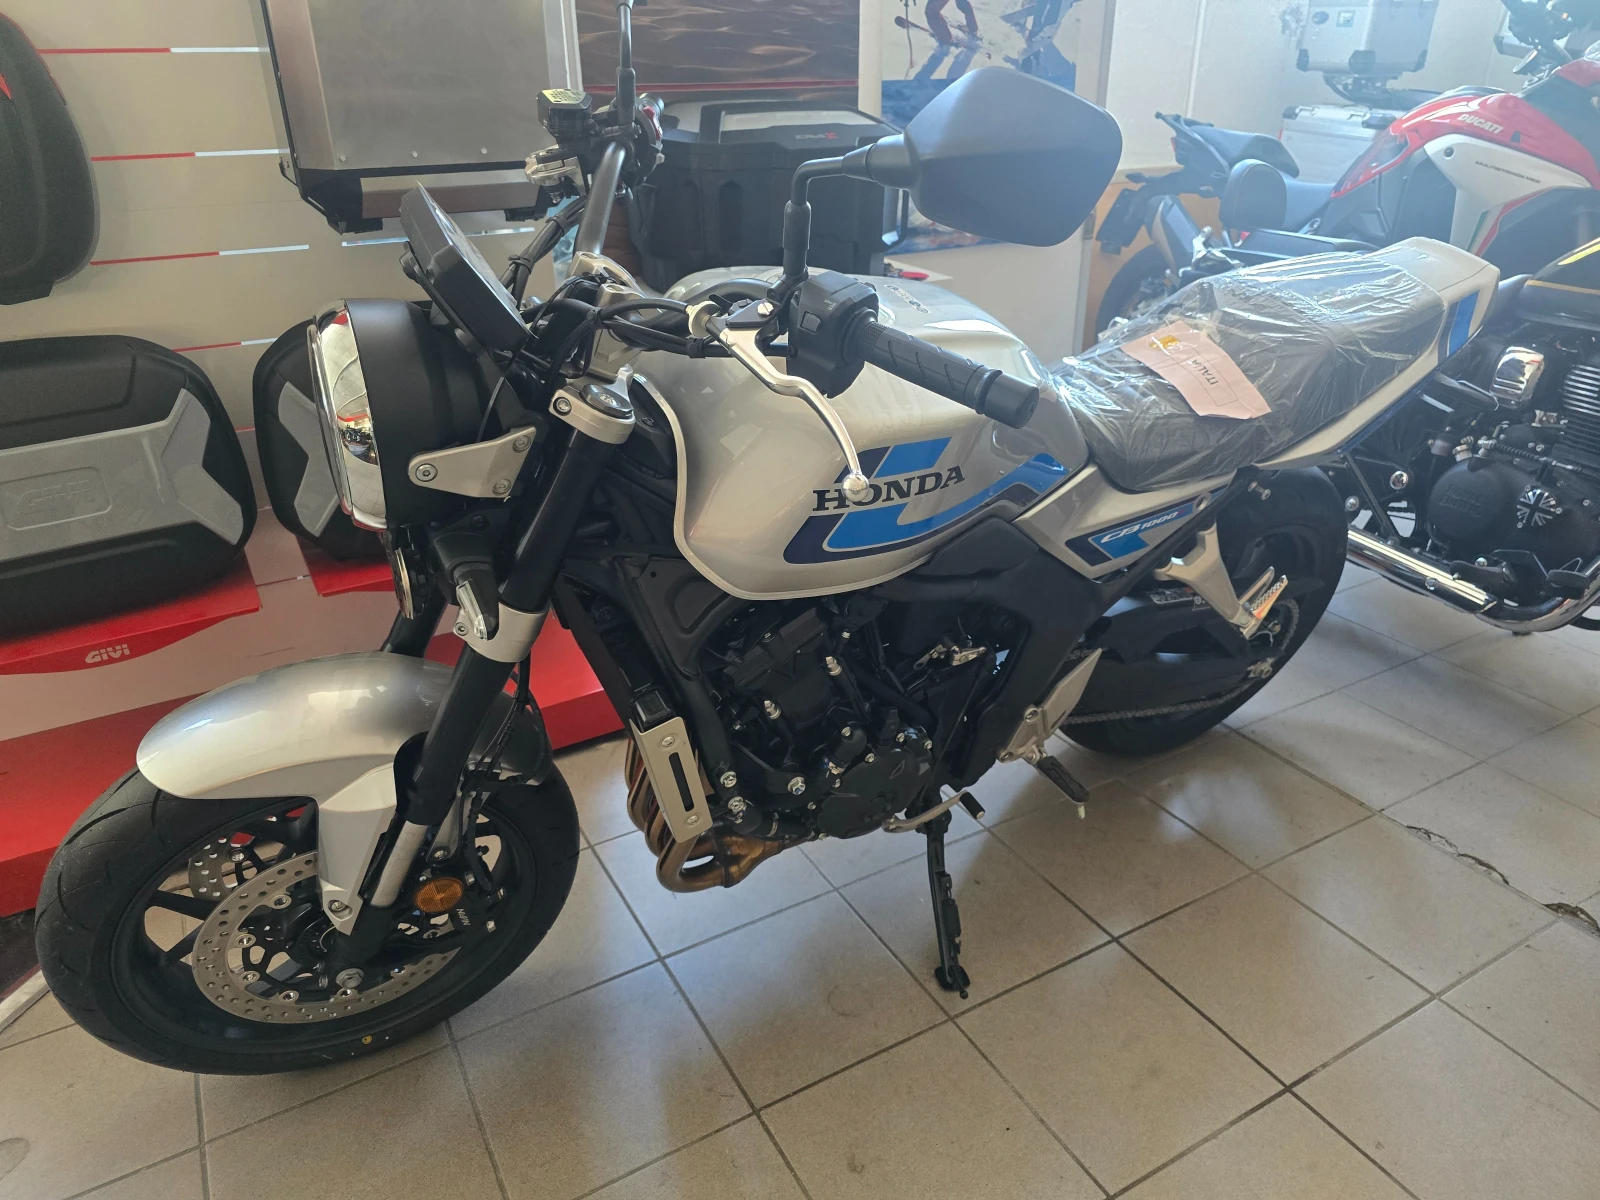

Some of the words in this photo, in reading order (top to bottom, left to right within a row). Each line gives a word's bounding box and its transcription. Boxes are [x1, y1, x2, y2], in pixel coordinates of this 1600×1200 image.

[1457, 113, 1504, 134] DUCATI
[1191, 359, 1219, 386] ITALIA
[812, 465, 966, 512] HONDA
[84, 643, 131, 664] GIVI
